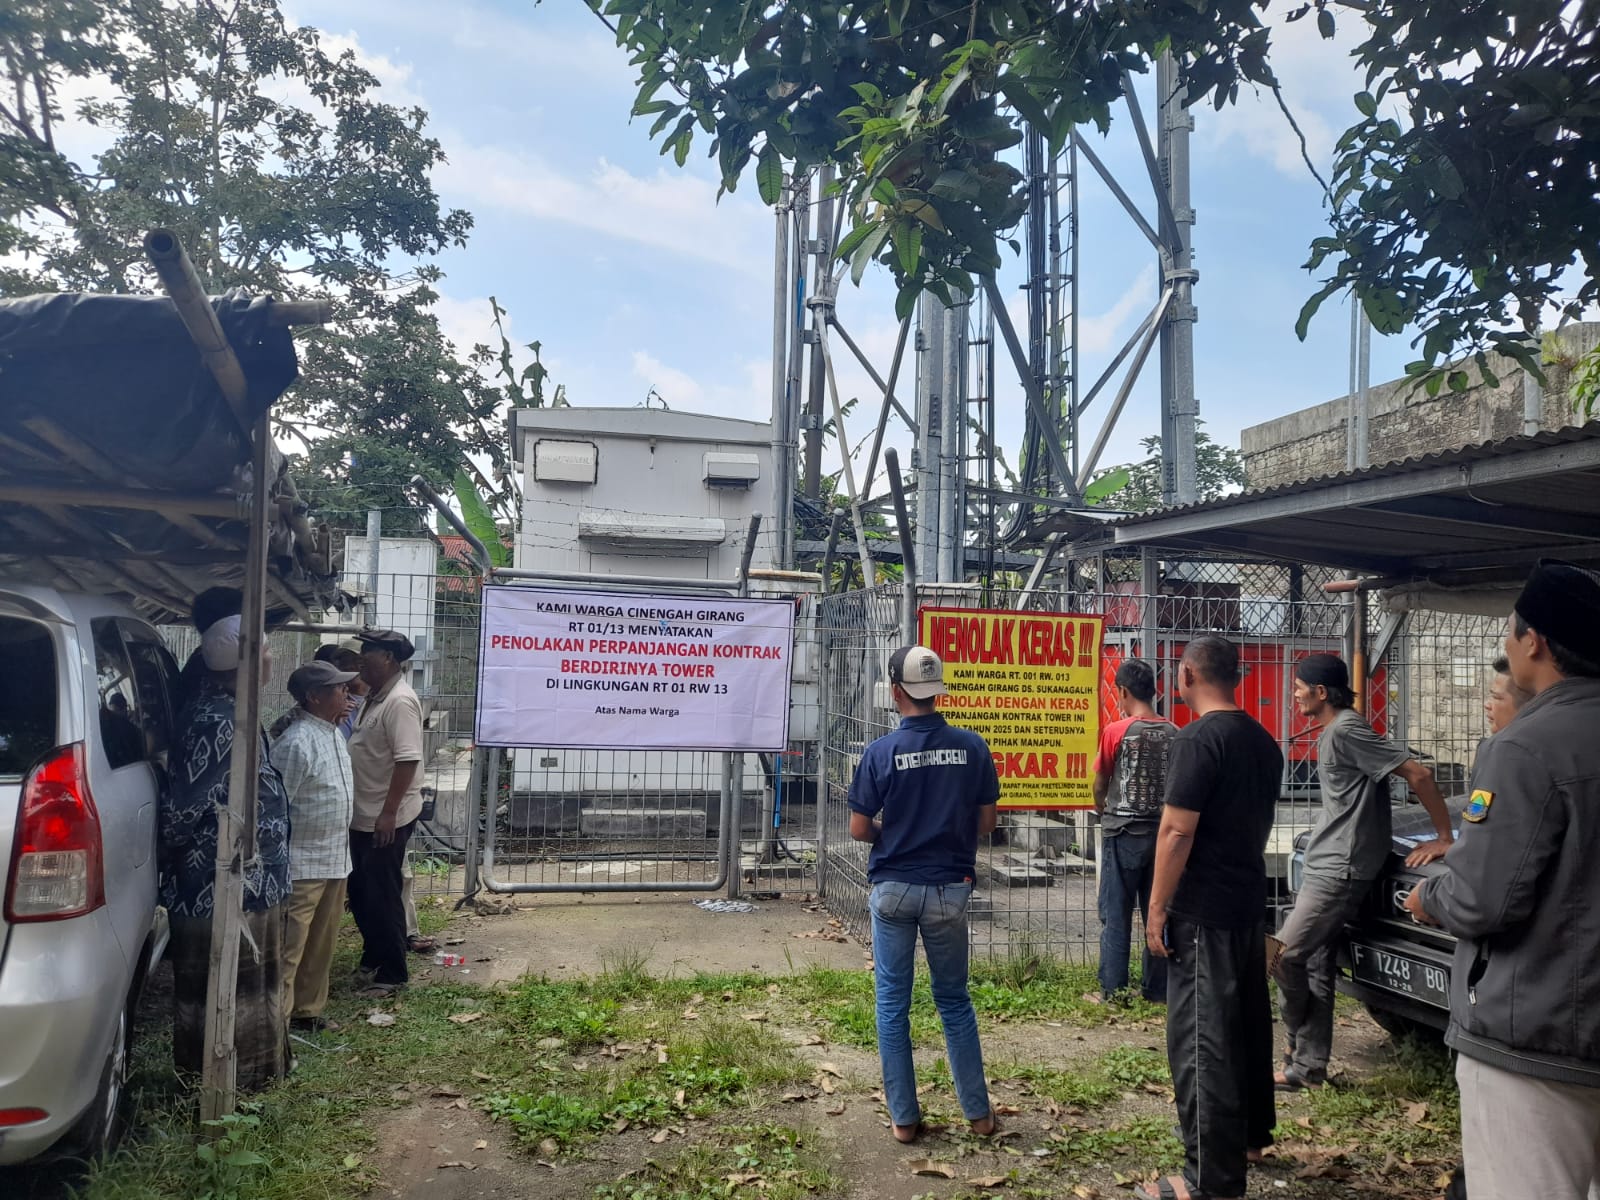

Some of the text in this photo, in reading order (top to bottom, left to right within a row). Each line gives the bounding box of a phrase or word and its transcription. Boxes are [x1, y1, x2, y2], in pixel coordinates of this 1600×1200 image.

[537, 602, 745, 622] KAMI WARGA CINENGAH GIRANG
[569, 622, 713, 638] RT 01/13 MENYATAKAN
[491, 635, 782, 660] PENOLAKAN PERPANJANGAN KONTRAK
[930, 616, 1015, 664] MENOLAK
[1018, 619, 1075, 668] KERAS
[561, 659, 715, 678] BERDIRINYA TOWER
[954, 670, 1070, 681] KAMI WARGA RT. 001 RW. 013
[546, 678, 728, 695] DI LINGKUNGAN RT 01 RW 13
[988, 683, 1019, 693] GIRANG
[1021, 684, 1034, 693] DS.
[1036, 684, 1093, 694] SUKANAGALIH
[995, 696, 1046, 709] DENGAN
[1050, 698, 1089, 710] KERAS
[595, 706, 680, 718] Atas Nama Warga
[1002, 712, 1042, 722] KONTRAK
[1045, 713, 1071, 722] TOWER
[1074, 714, 1085, 722] INI
[993, 725, 1012, 734] 2025
[1014, 726, 1031, 734] DAN
[1034, 726, 1085, 735] SETERUSNYA
[993, 738, 1018, 747] PIHAK
[1021, 738, 1064, 748] MANAPUN.
[1354, 945, 1364, 965] F
[1376, 952, 1411, 980] 1248
